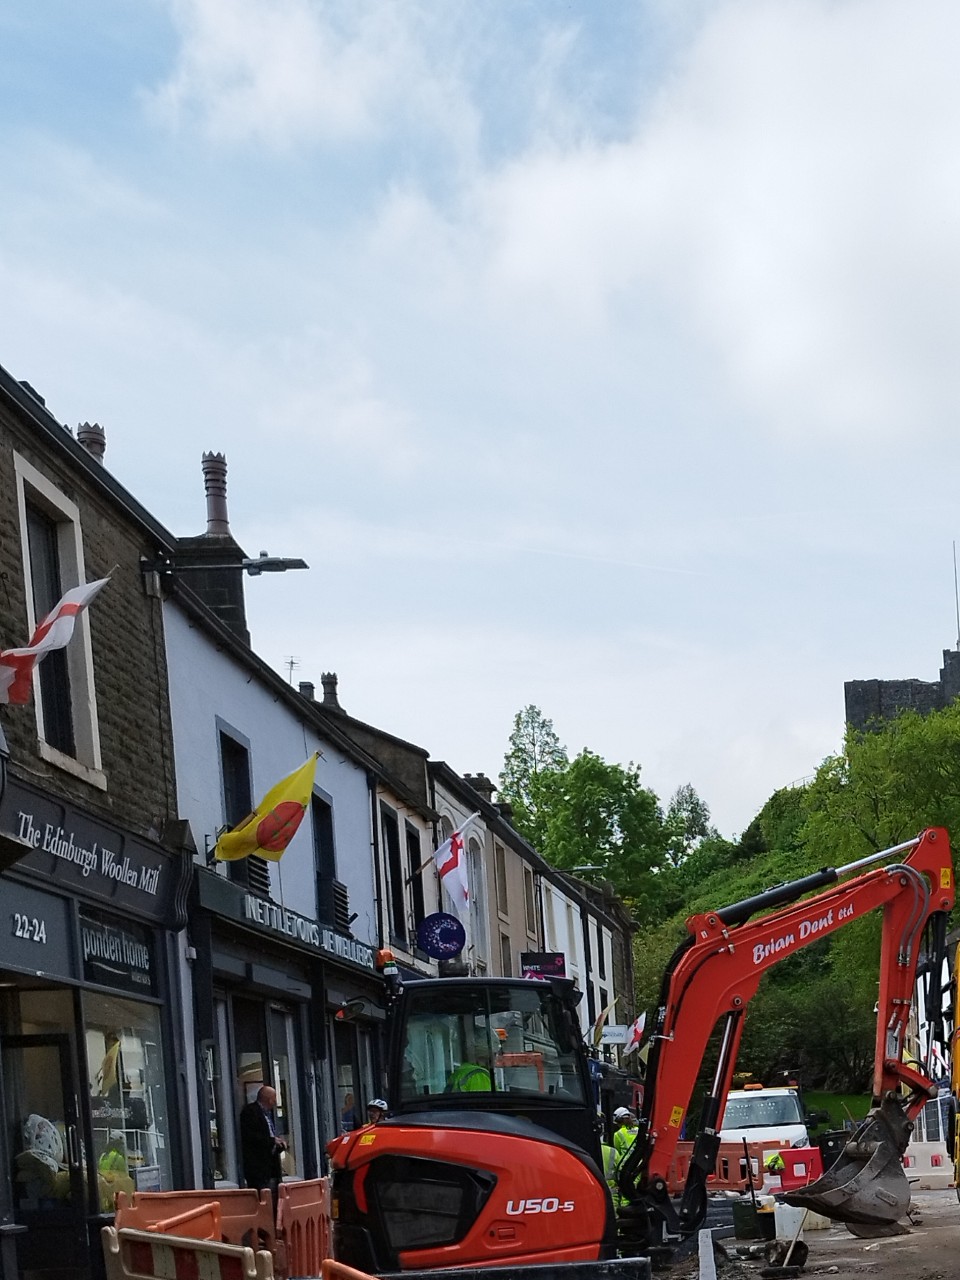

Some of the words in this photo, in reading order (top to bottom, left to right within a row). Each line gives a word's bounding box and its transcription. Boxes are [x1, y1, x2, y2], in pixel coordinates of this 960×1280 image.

[18, 811, 41, 847] The
[42, 823, 98, 876] Edinburgh
[101, 848, 138, 887] Woollen
[15, 913, 47, 944] 22-24
[83, 926, 122, 961] ponden
[122, 932, 150, 970] home
[245, 894, 319, 946] NETTLETONS
[322, 929, 374, 969] JEWELLERS
[753, 934, 794, 964] Brian
[799, 909, 833, 939] Dent
